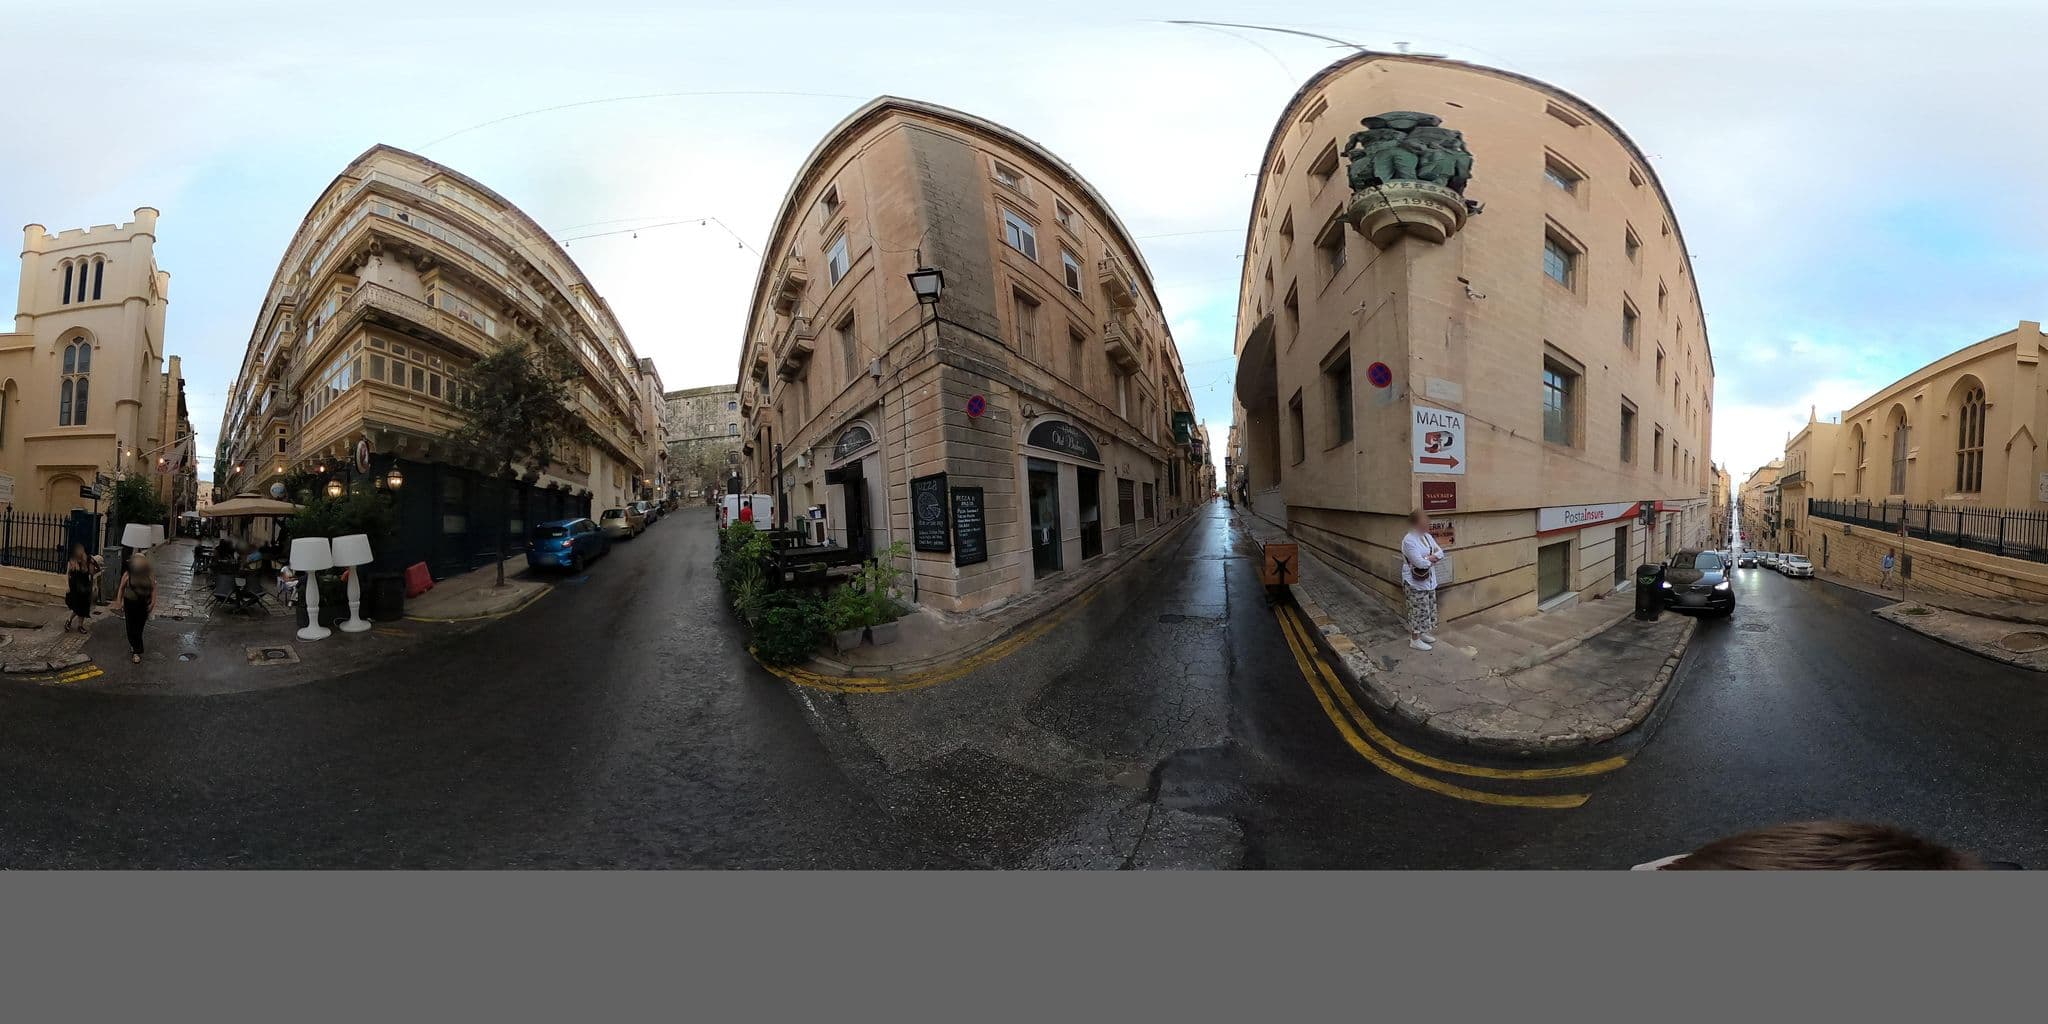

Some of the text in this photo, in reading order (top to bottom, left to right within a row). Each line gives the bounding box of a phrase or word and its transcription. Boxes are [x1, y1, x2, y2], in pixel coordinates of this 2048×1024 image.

[1416, 411, 1461, 430] MALTA
[1424, 430, 1455, 454] 5D
[1564, 508, 1604, 524] PostaInsure
